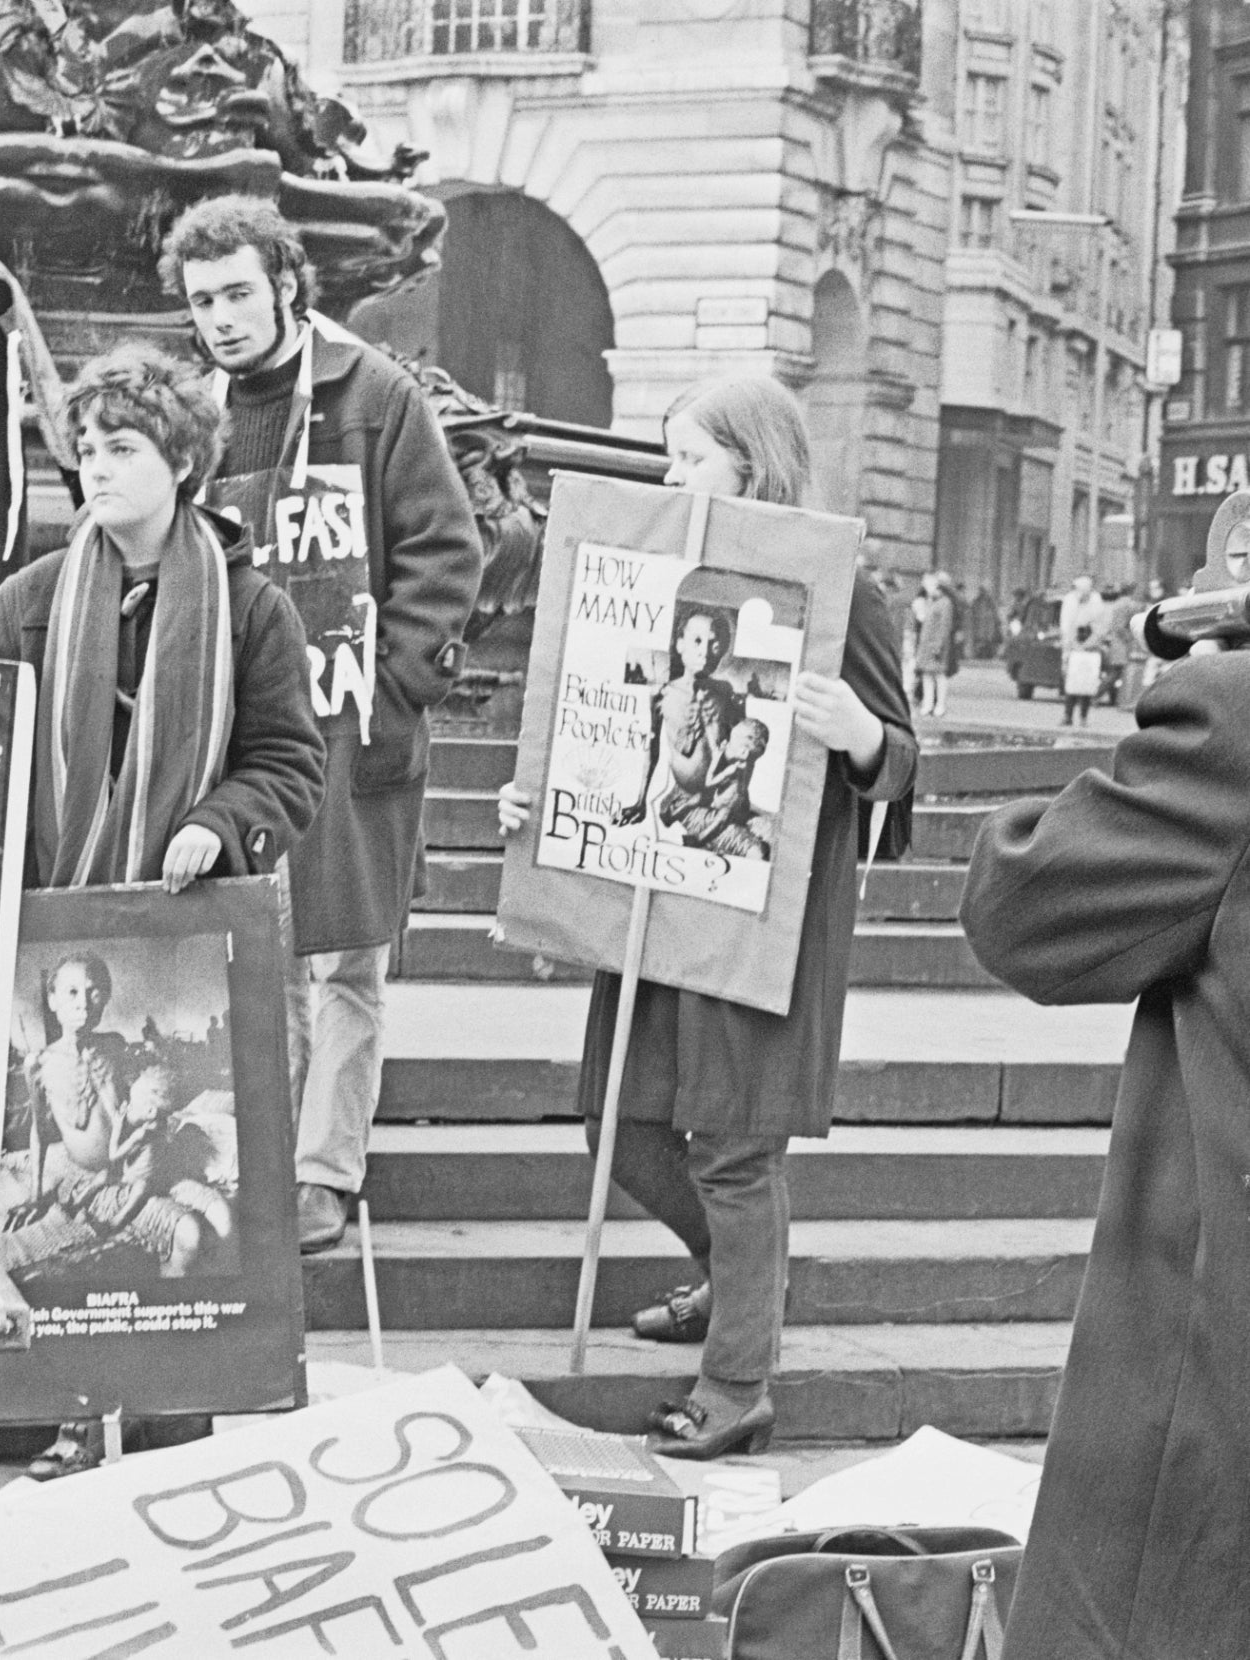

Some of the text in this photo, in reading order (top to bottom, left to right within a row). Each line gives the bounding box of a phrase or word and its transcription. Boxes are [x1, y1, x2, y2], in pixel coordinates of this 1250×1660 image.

[275, 494, 368, 563] FAST
[583, 554, 645, 590] HOW
[575, 592, 664, 633] MANY
[563, 674, 637, 715] Biafran
[559, 708, 622, 747] People
[51, 1305, 132, 1322] Government
[133, 1302, 193, 1319] supports
[193, 1300, 220, 1316] this
[221, 1302, 247, 1315] war
[86, 1291, 139, 1307] BIAFRA
[66, 1319, 88, 1334] the
[89, 1317, 133, 1336] public,
[134, 1315, 171, 1332] could
[172, 1316, 202, 1332] stop
[617, 1531, 676, 1551] PAPER
[645, 1594, 701, 1611] PAPER
